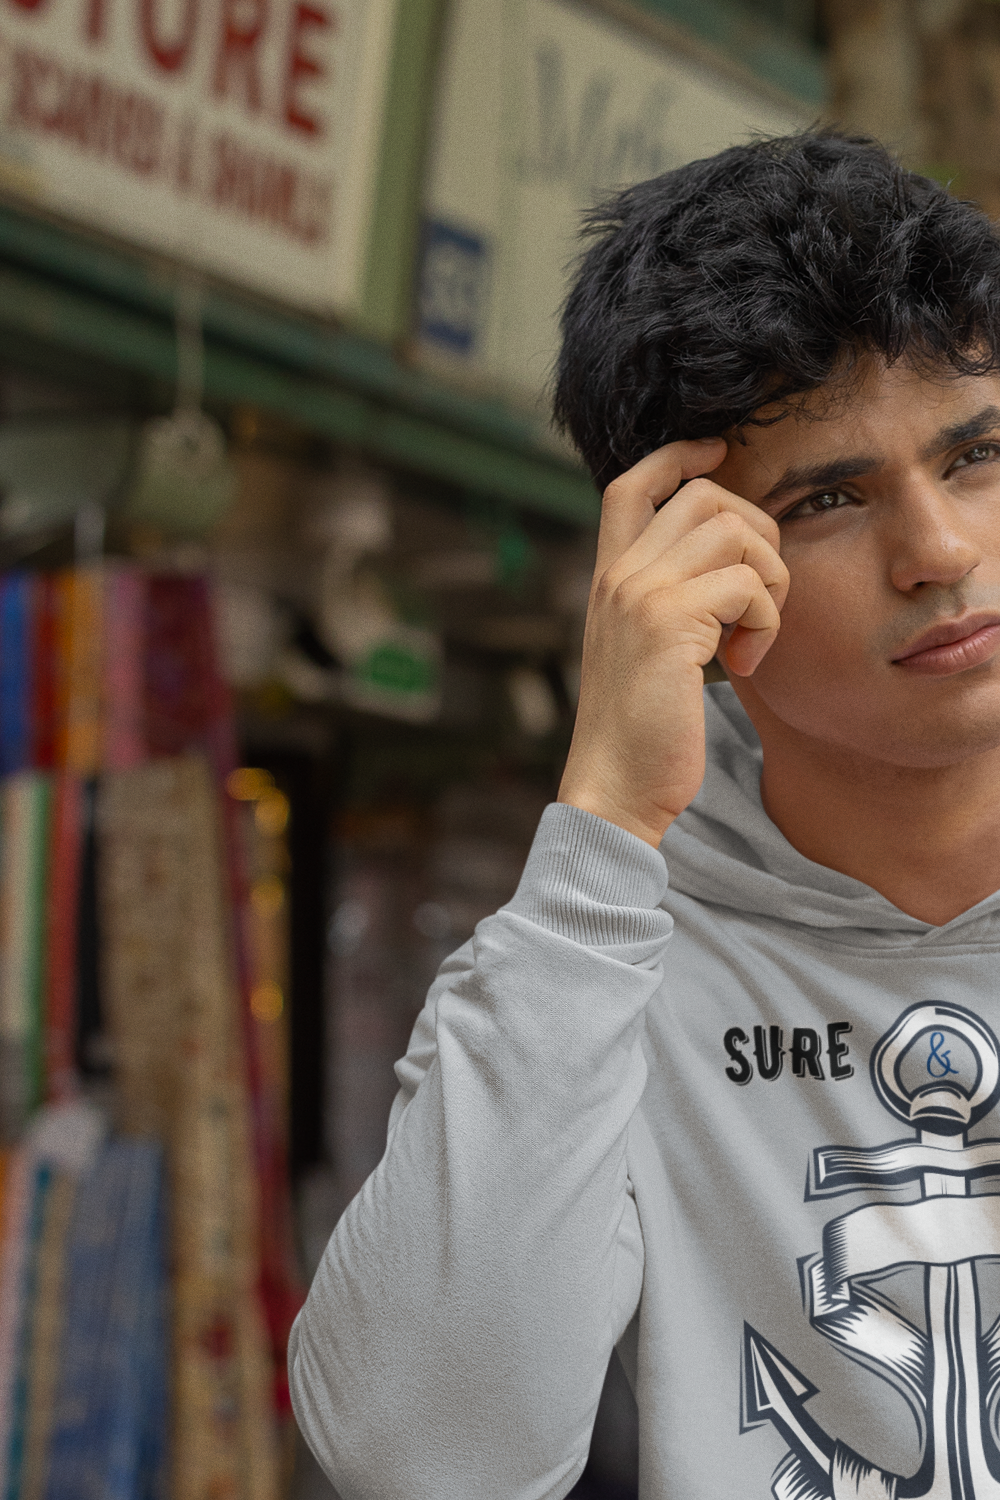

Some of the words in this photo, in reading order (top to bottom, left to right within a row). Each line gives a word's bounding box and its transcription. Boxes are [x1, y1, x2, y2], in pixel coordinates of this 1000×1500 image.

[9, 0, 333, 138] ORE
[723, 1021, 855, 1085] SURE
[926, 1031, 959, 1078] &
